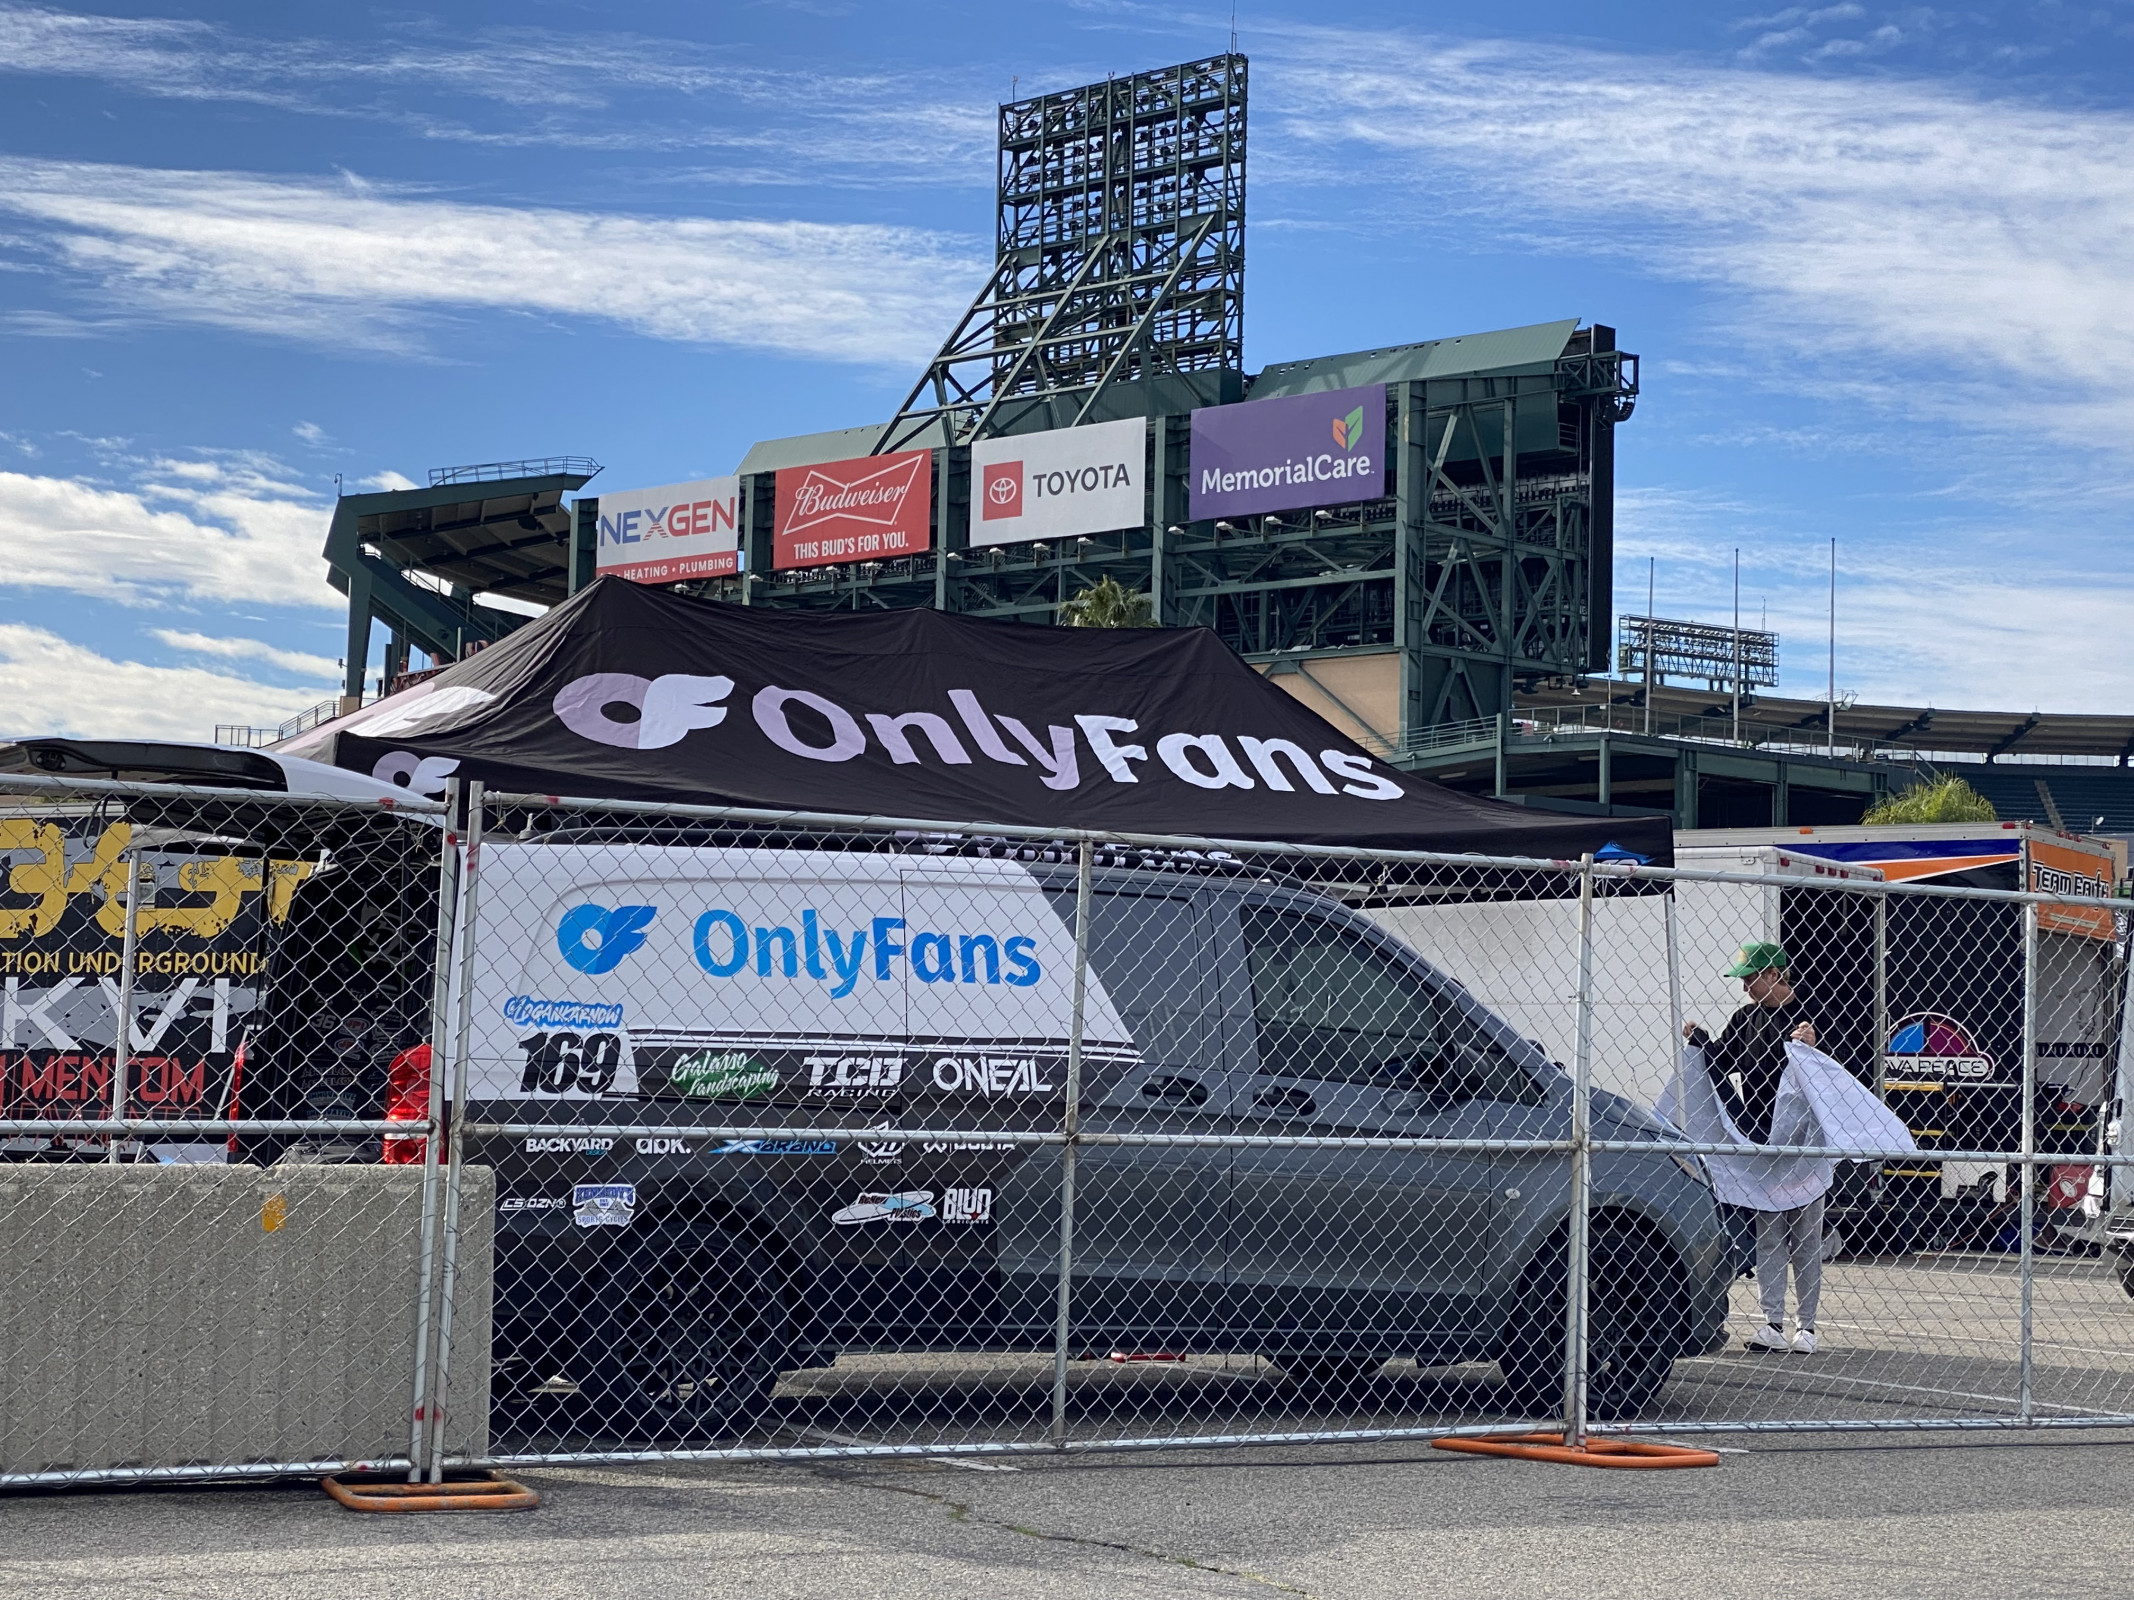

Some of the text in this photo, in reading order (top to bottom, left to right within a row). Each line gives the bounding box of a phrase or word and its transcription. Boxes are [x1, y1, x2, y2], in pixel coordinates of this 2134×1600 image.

[1033, 463, 1131, 498] TOYOTA
[1201, 453, 1371, 495] MemorialCare
[795, 482, 906, 516] Budweiser
[600, 497, 736, 547] NEXGEN
[794, 531, 909, 560] THIS BUD'S FOR YOU.
[623, 565, 668, 581] HEATING
[679, 557, 734, 574] PLUMBING
[752, 684, 1405, 800] OnlyFans
[2032, 861, 2071, 896] TEAM
[68, 952, 267, 974] UNDRGROUND
[692, 909, 1042, 1000] OnlyFans
[518, 1032, 621, 1094] 169
[525, 1138, 614, 1152] BACKYARD
